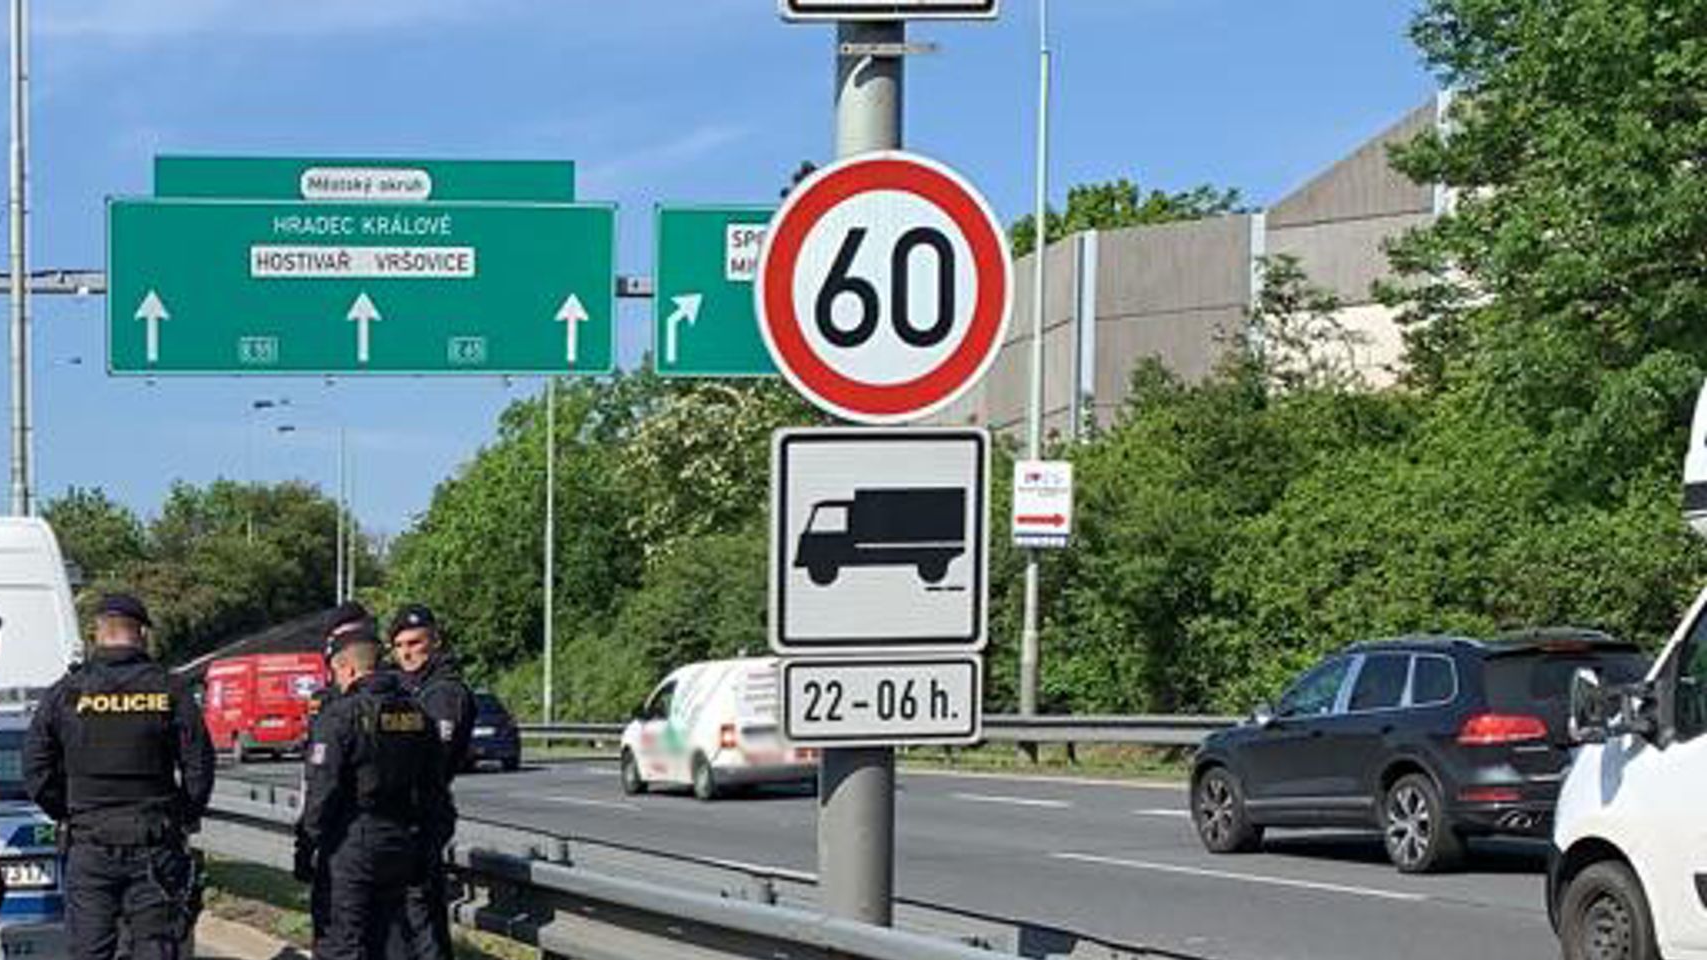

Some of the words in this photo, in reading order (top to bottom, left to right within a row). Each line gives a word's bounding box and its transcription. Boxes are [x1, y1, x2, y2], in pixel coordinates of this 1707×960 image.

[380, 176, 423, 192] okruh
[274, 215, 354, 235] HRADEC
[362, 212, 452, 236] KRÁLOVÉ
[257, 250, 352, 271] HOSTIVAŘ
[375, 251, 469, 271] VRŠOVICE
[815, 226, 956, 348] 60
[76, 692, 170, 713] POLICIE
[930, 678, 959, 720] h.
